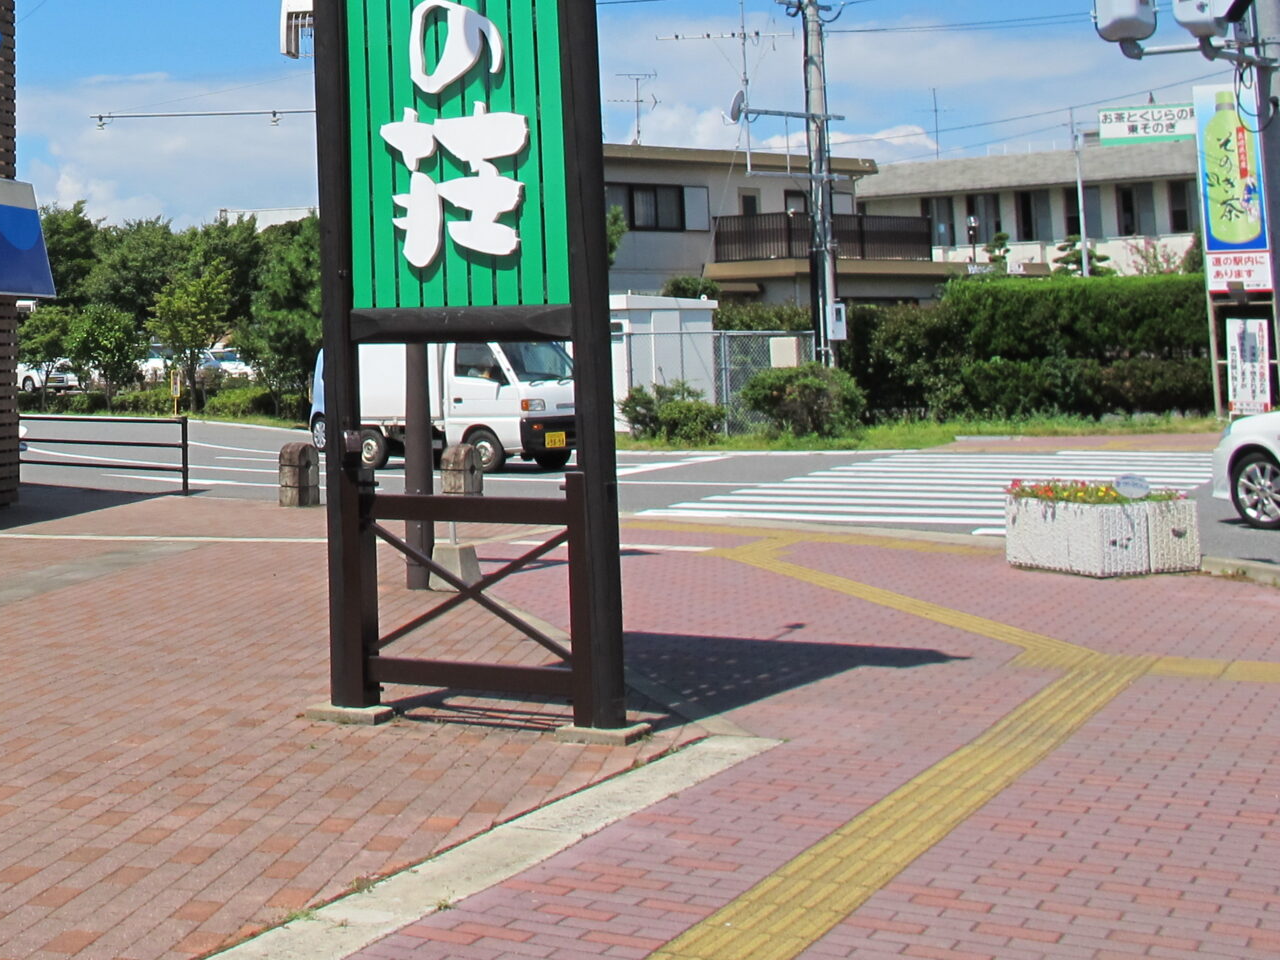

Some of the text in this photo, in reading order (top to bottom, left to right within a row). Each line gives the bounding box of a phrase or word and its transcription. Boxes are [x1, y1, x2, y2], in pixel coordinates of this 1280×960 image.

[1127, 122, 1177, 134] 東そのぎ
[1212, 256, 1265, 266] 道の駅内に
[1213, 269, 1254, 279] あります
